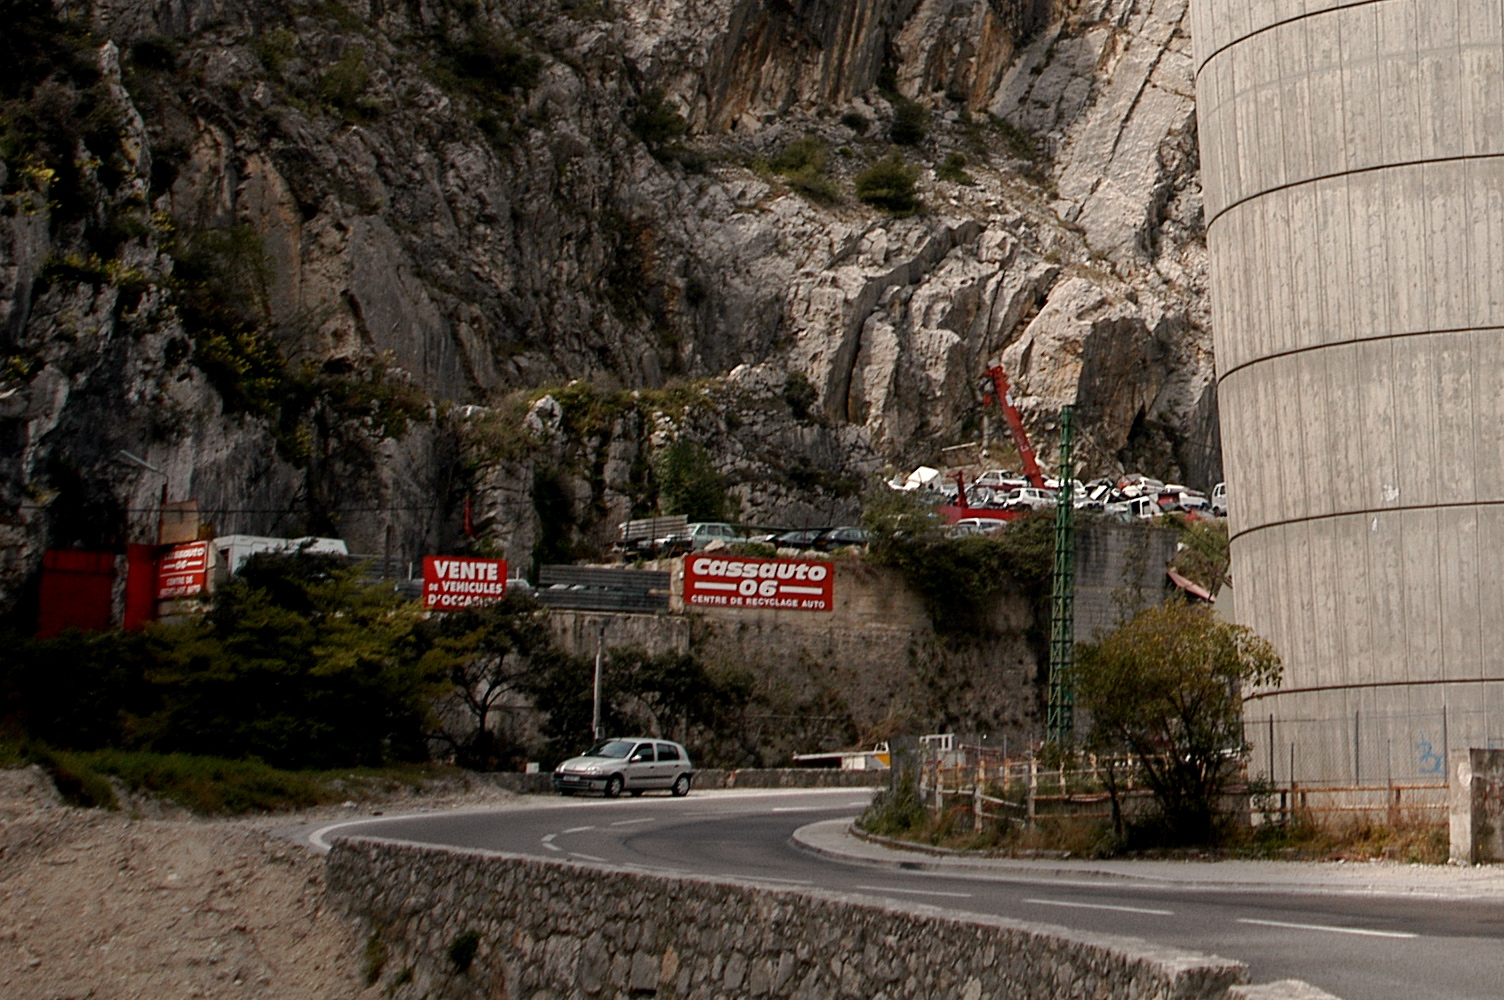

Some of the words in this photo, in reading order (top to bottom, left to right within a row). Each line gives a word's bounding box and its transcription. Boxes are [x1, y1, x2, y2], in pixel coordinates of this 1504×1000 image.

[433, 560, 499, 581] VENTE
[441, 580, 503, 595] VEHICULES
[738, 579, 779, 597] 06
[691, 594, 728, 605] CENTRE
[730, 597, 743, 606] DE
[745, 597, 799, 608] RECYCLAGE
[801, 600, 826, 609] AUTO
